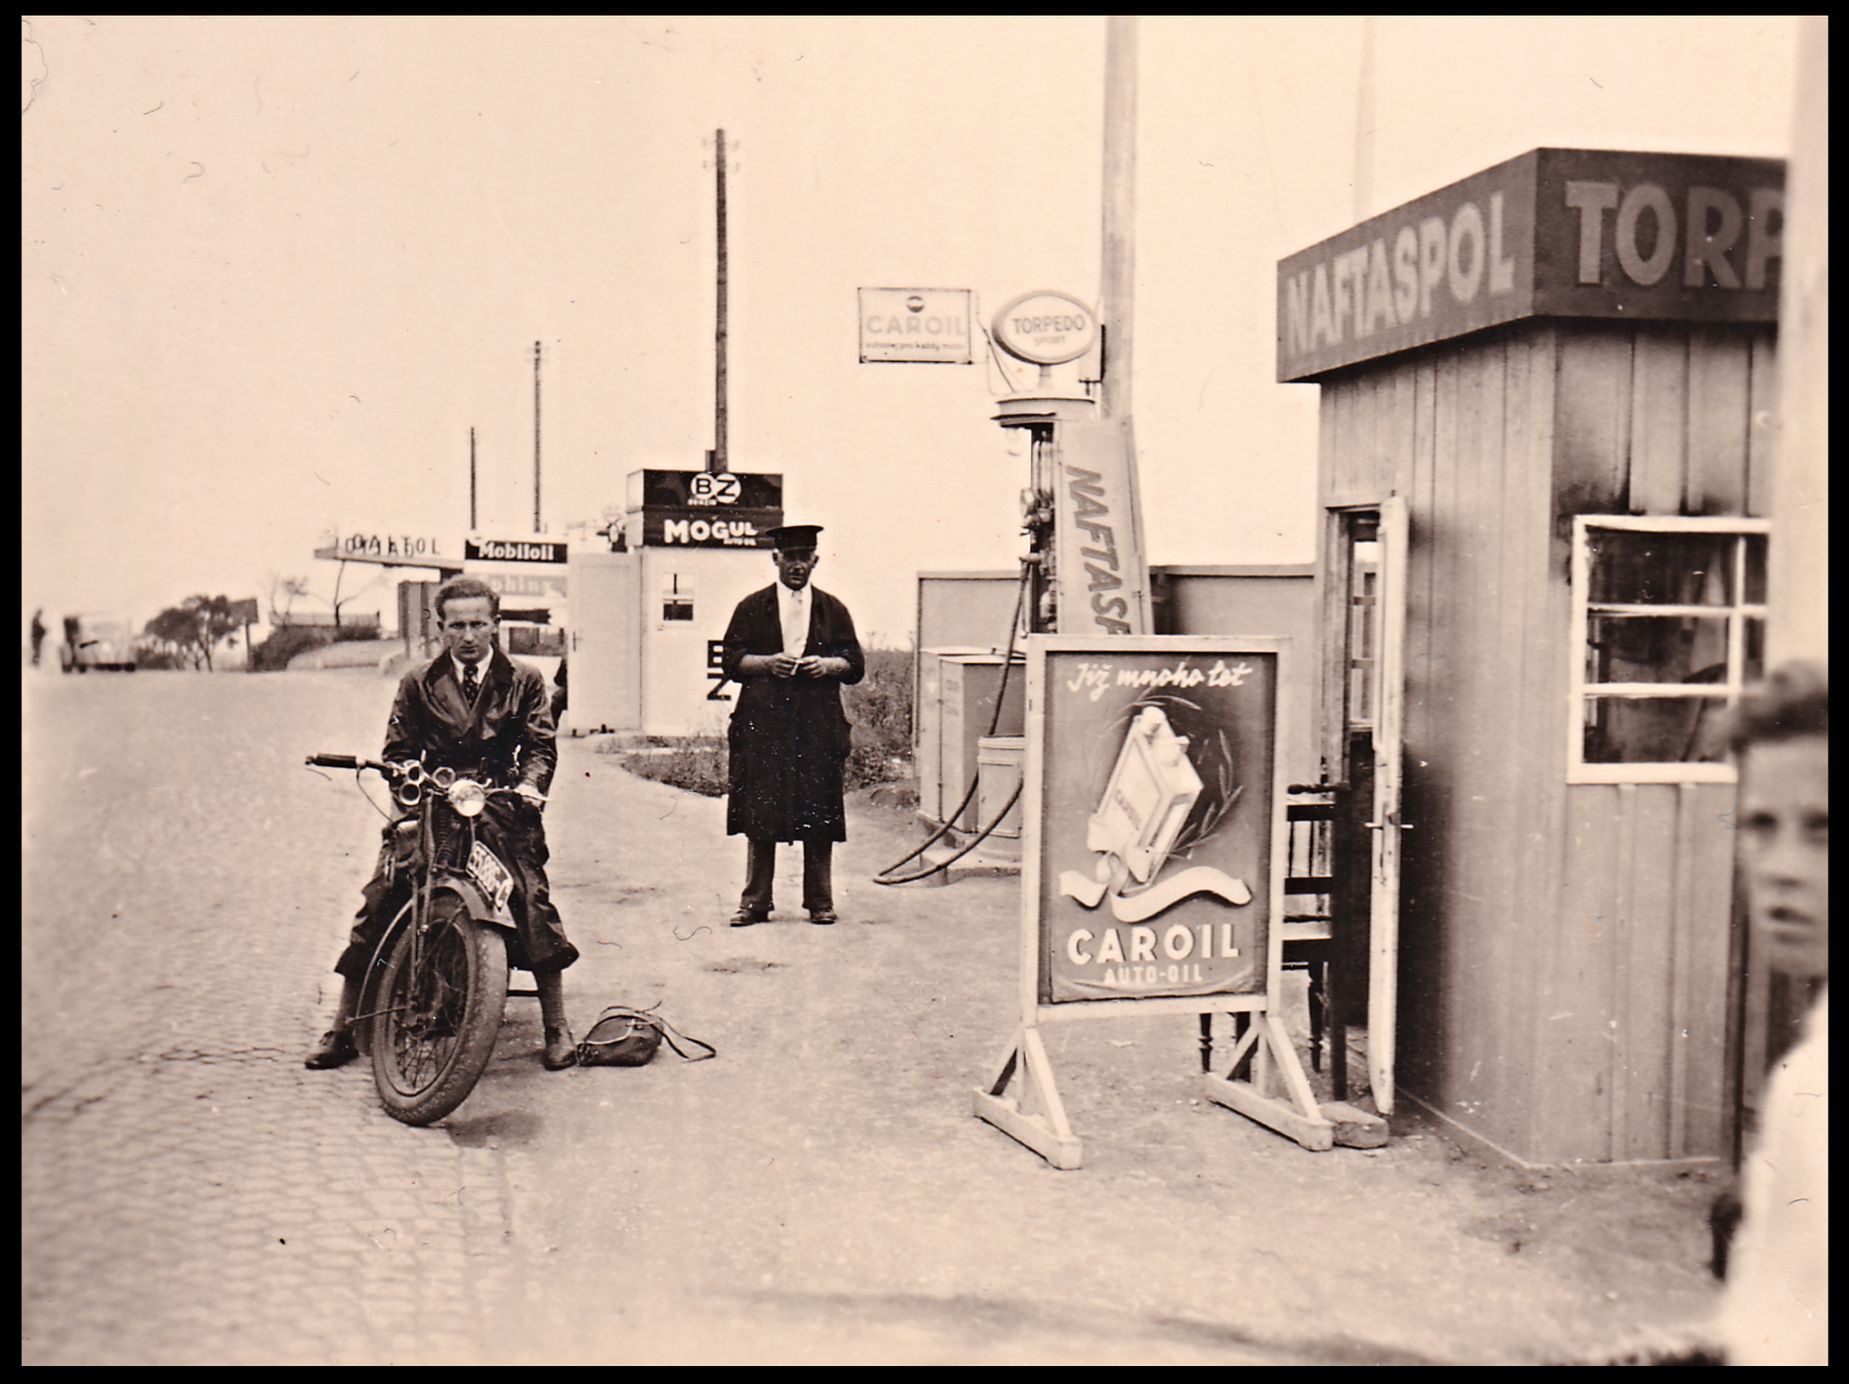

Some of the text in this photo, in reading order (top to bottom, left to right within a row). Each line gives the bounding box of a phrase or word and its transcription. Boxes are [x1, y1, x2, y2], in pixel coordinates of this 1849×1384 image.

[1565, 180, 1784, 290] TORP
[1287, 190, 1515, 356] NAFTASPOL
[866, 315, 965, 336] CAROIL
[1012, 314, 1085, 334] TORPEDO
[695, 477, 737, 497] BZ
[663, 519, 758, 544] MOGUL
[478, 540, 554, 561] Mobiloil
[1067, 663, 1113, 702] Již
[1116, 658, 1205, 688] mnoho
[1067, 923, 1241, 966] CAROIL
[1103, 963, 1204, 986] AUTO-OIL
